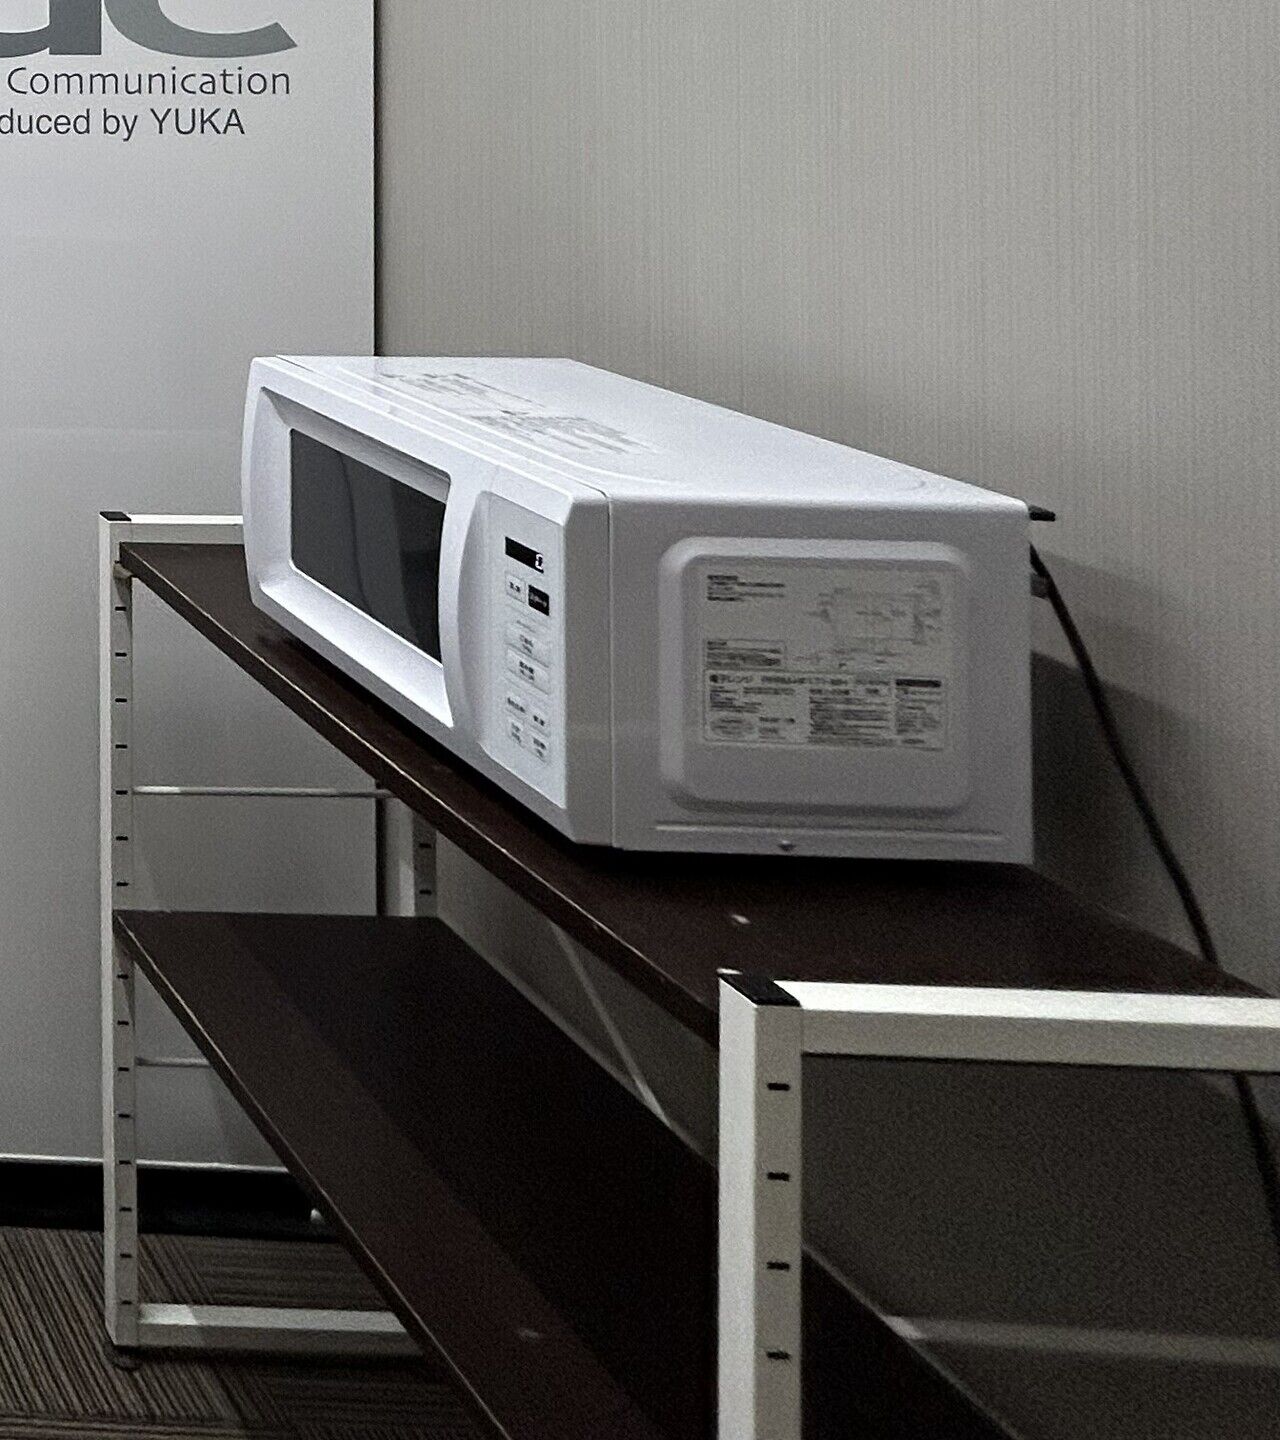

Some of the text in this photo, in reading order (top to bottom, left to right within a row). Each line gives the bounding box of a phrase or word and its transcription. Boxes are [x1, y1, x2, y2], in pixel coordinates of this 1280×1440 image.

[8, 65, 291, 96] Communication
[103, 108, 138, 142] by
[149, 108, 245, 135] YUKA
